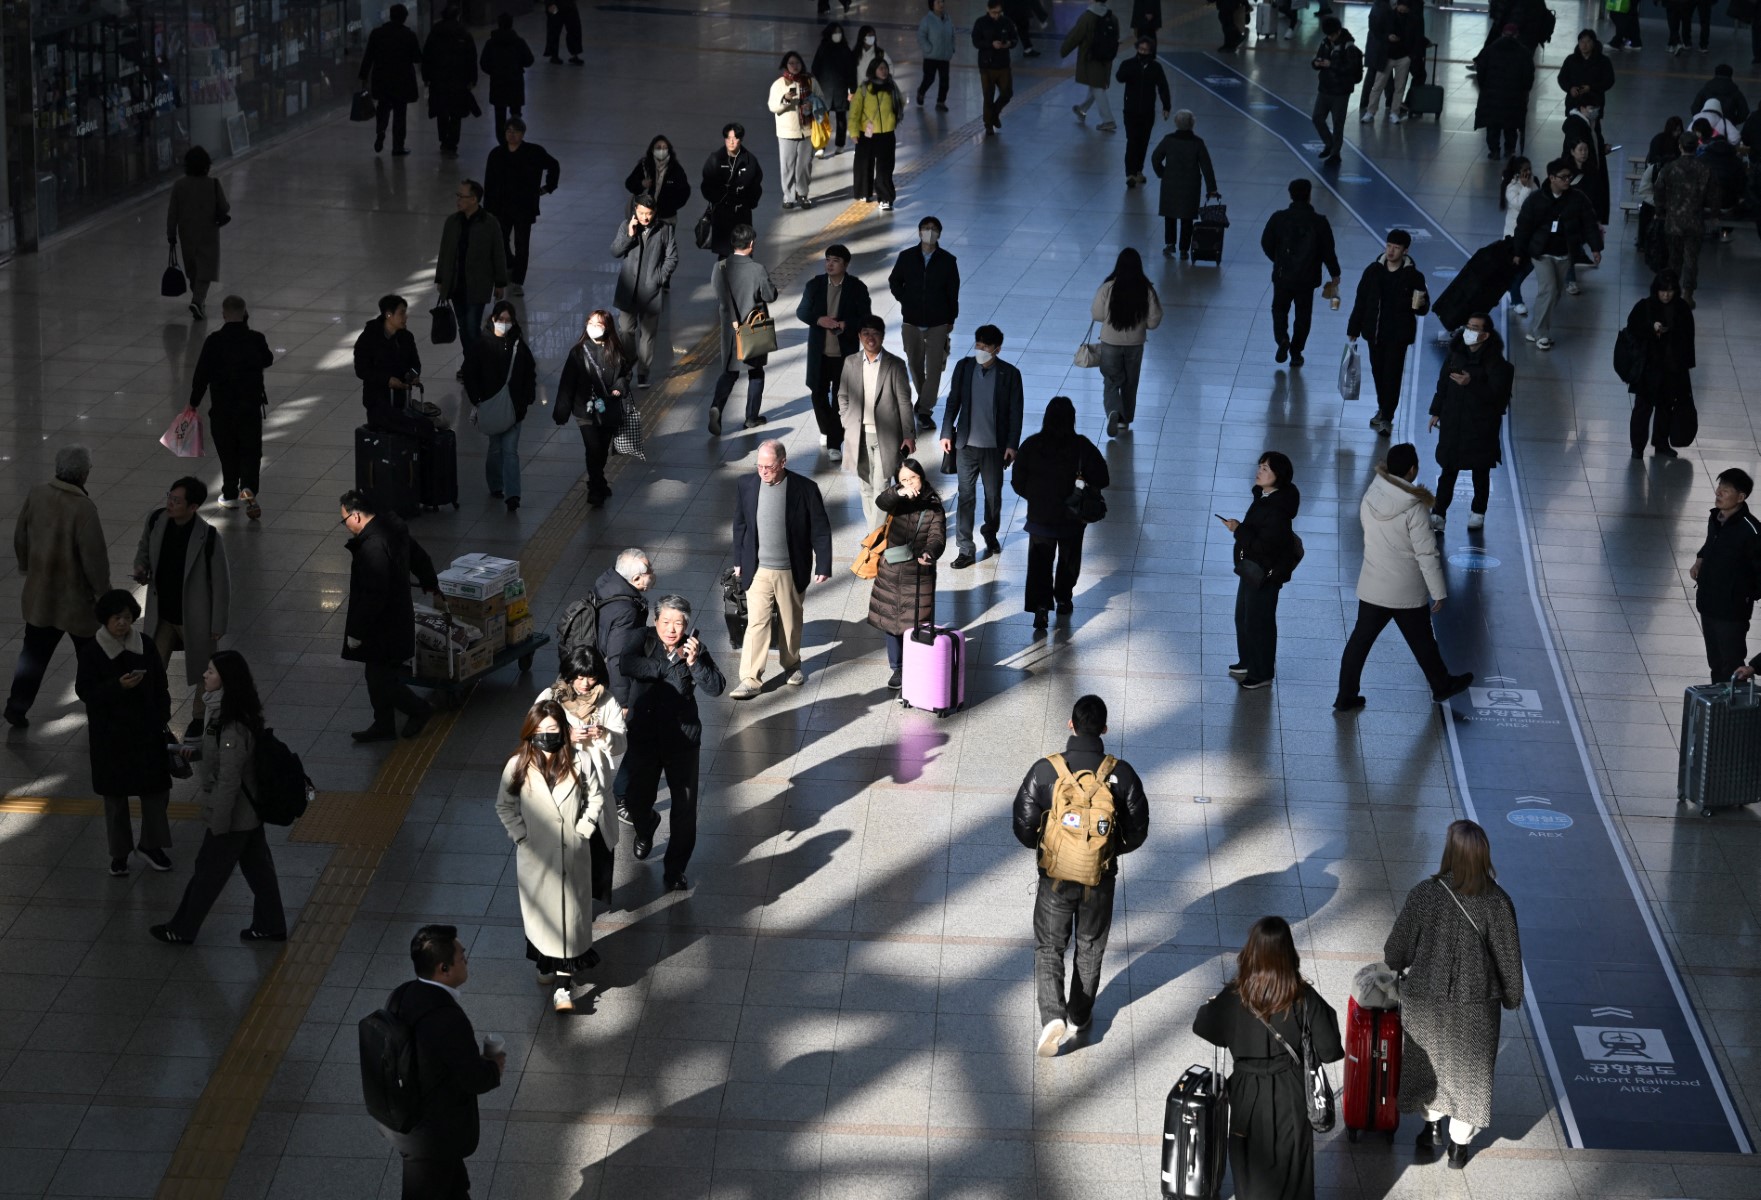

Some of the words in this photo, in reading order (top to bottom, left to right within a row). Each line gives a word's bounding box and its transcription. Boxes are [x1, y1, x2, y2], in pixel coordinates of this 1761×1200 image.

[1589, 1062, 1676, 1076] 공항철도
[1574, 1074, 1631, 1084] Airport
[1634, 1077, 1701, 1087] Railroad
[1619, 1086, 1663, 1094] AREX
